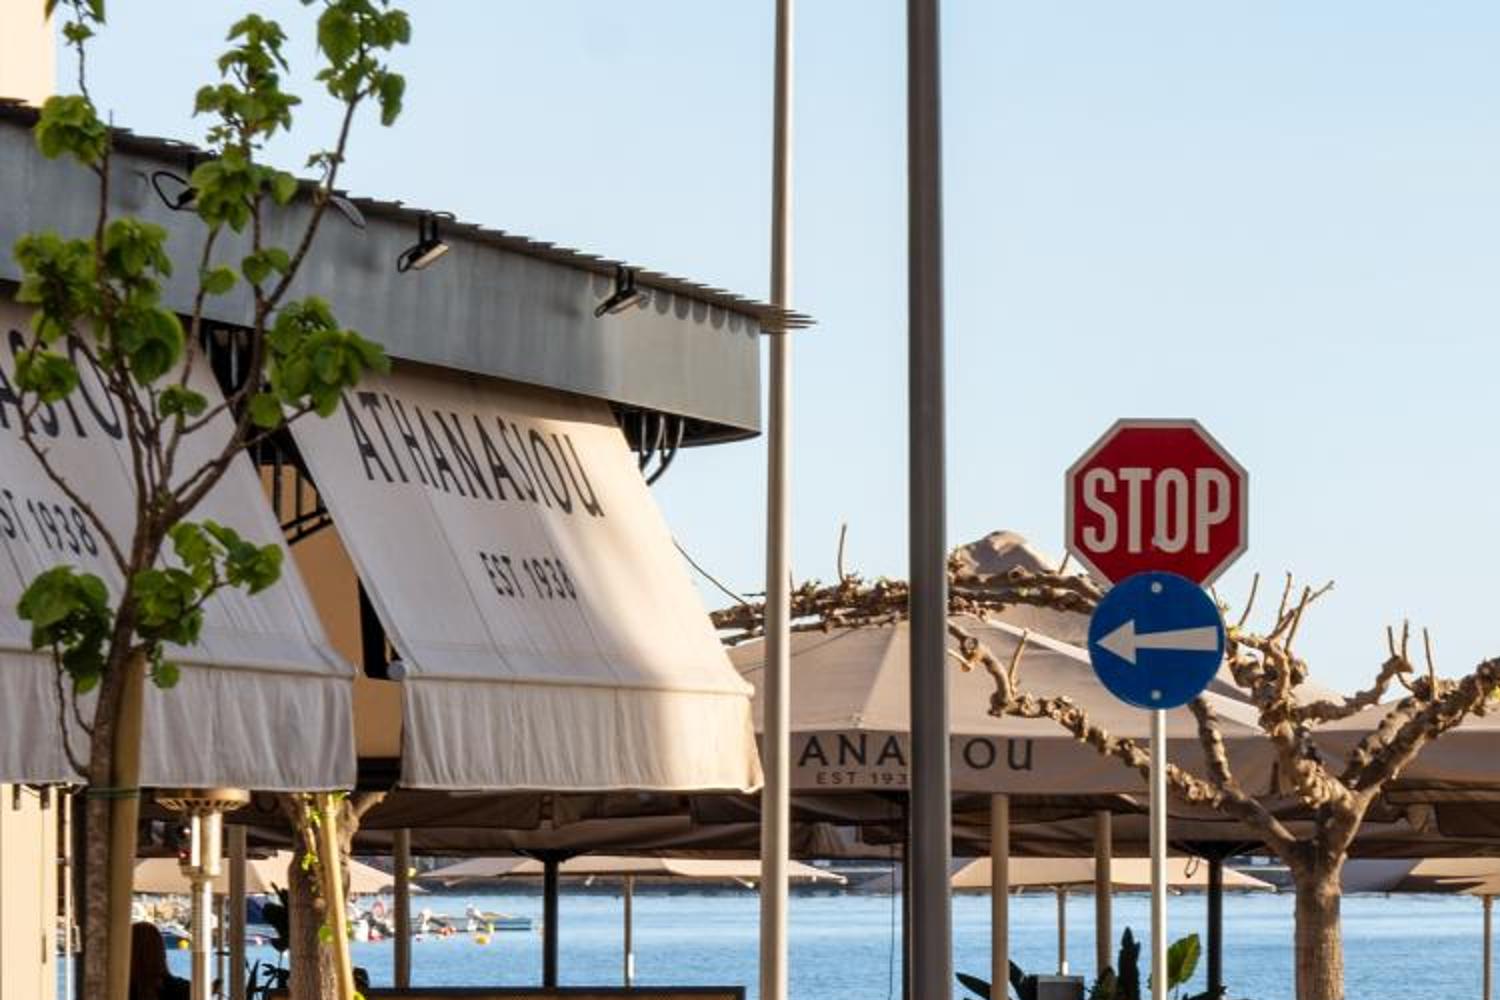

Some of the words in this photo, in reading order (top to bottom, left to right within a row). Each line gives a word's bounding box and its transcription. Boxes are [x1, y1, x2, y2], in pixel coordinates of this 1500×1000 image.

[341, 390, 605, 518] ATHANASIOU
[26, 498, 99, 557] 1938
[1082, 467, 1232, 554] STOP
[479, 551, 526, 599] EST
[522, 557, 578, 600] 1938
[815, 771, 856, 785] EST
[870, 772, 908, 785] 193
